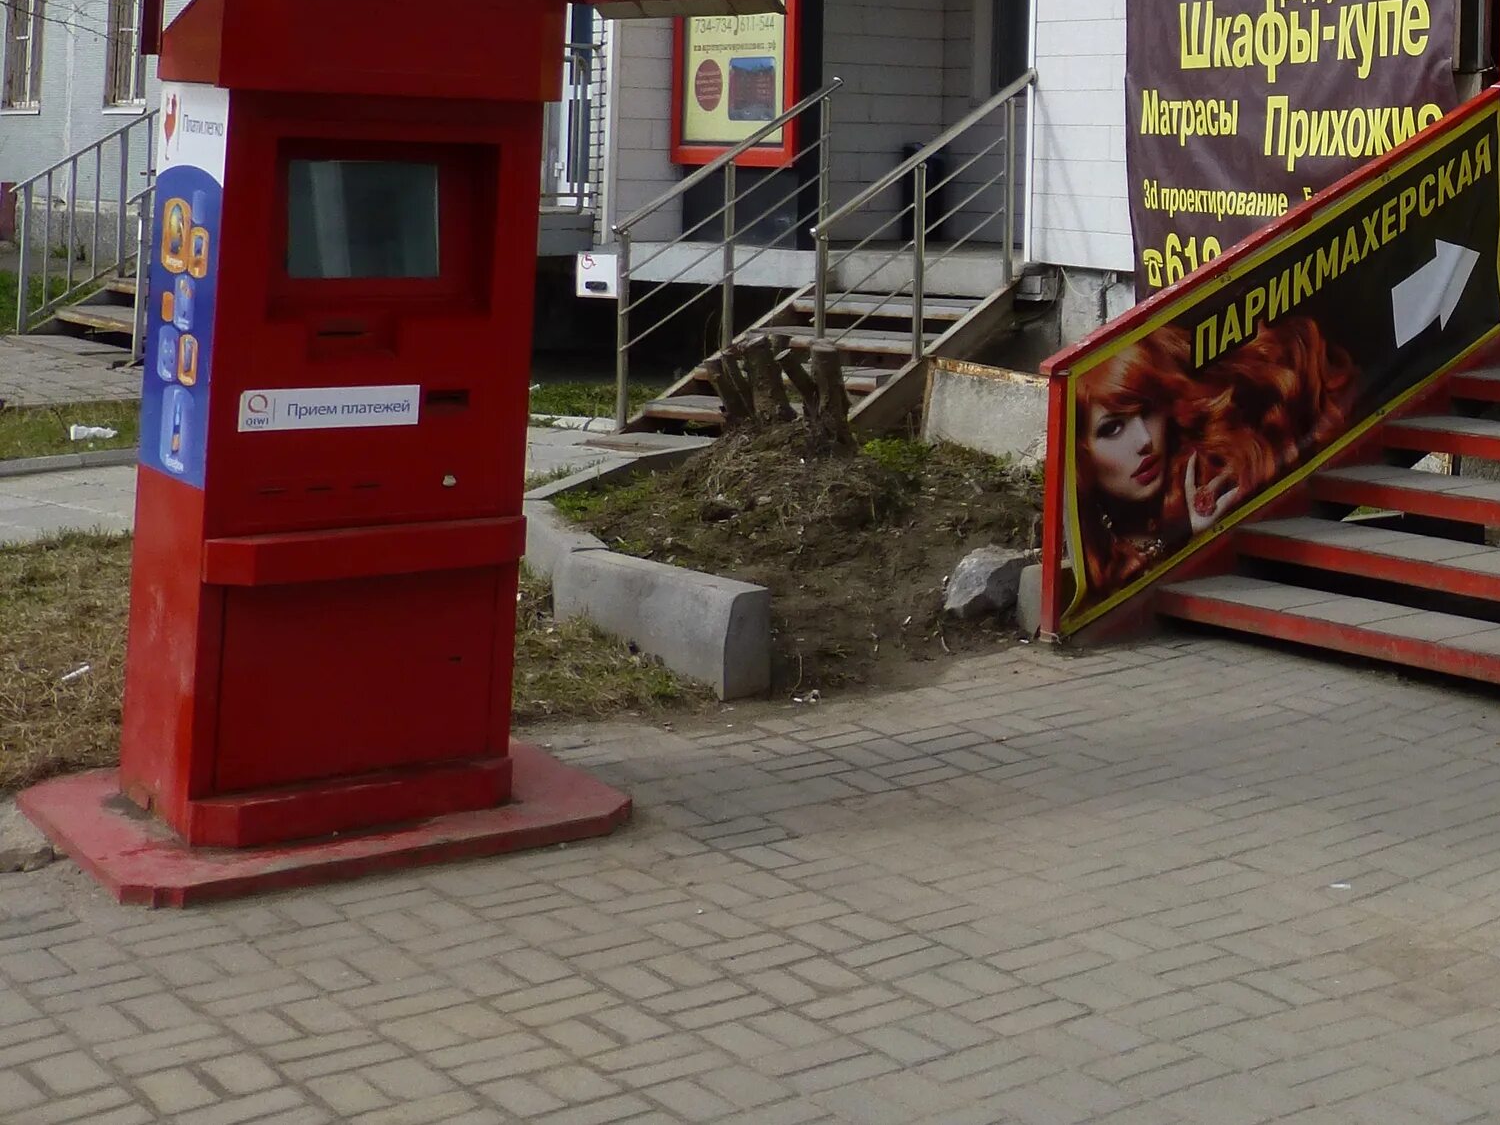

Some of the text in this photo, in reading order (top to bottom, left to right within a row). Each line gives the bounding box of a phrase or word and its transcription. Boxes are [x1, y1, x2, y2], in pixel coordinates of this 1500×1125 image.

[1140, 88, 1239, 146] Матрасы
[1143, 178, 1158, 210] 3d
[1160, 186, 1289, 222] проектирование
[1193, 132, 1494, 369] ПАРИКМАХЕРСКАЯ
[287, 399, 411, 419] Прием платежей
